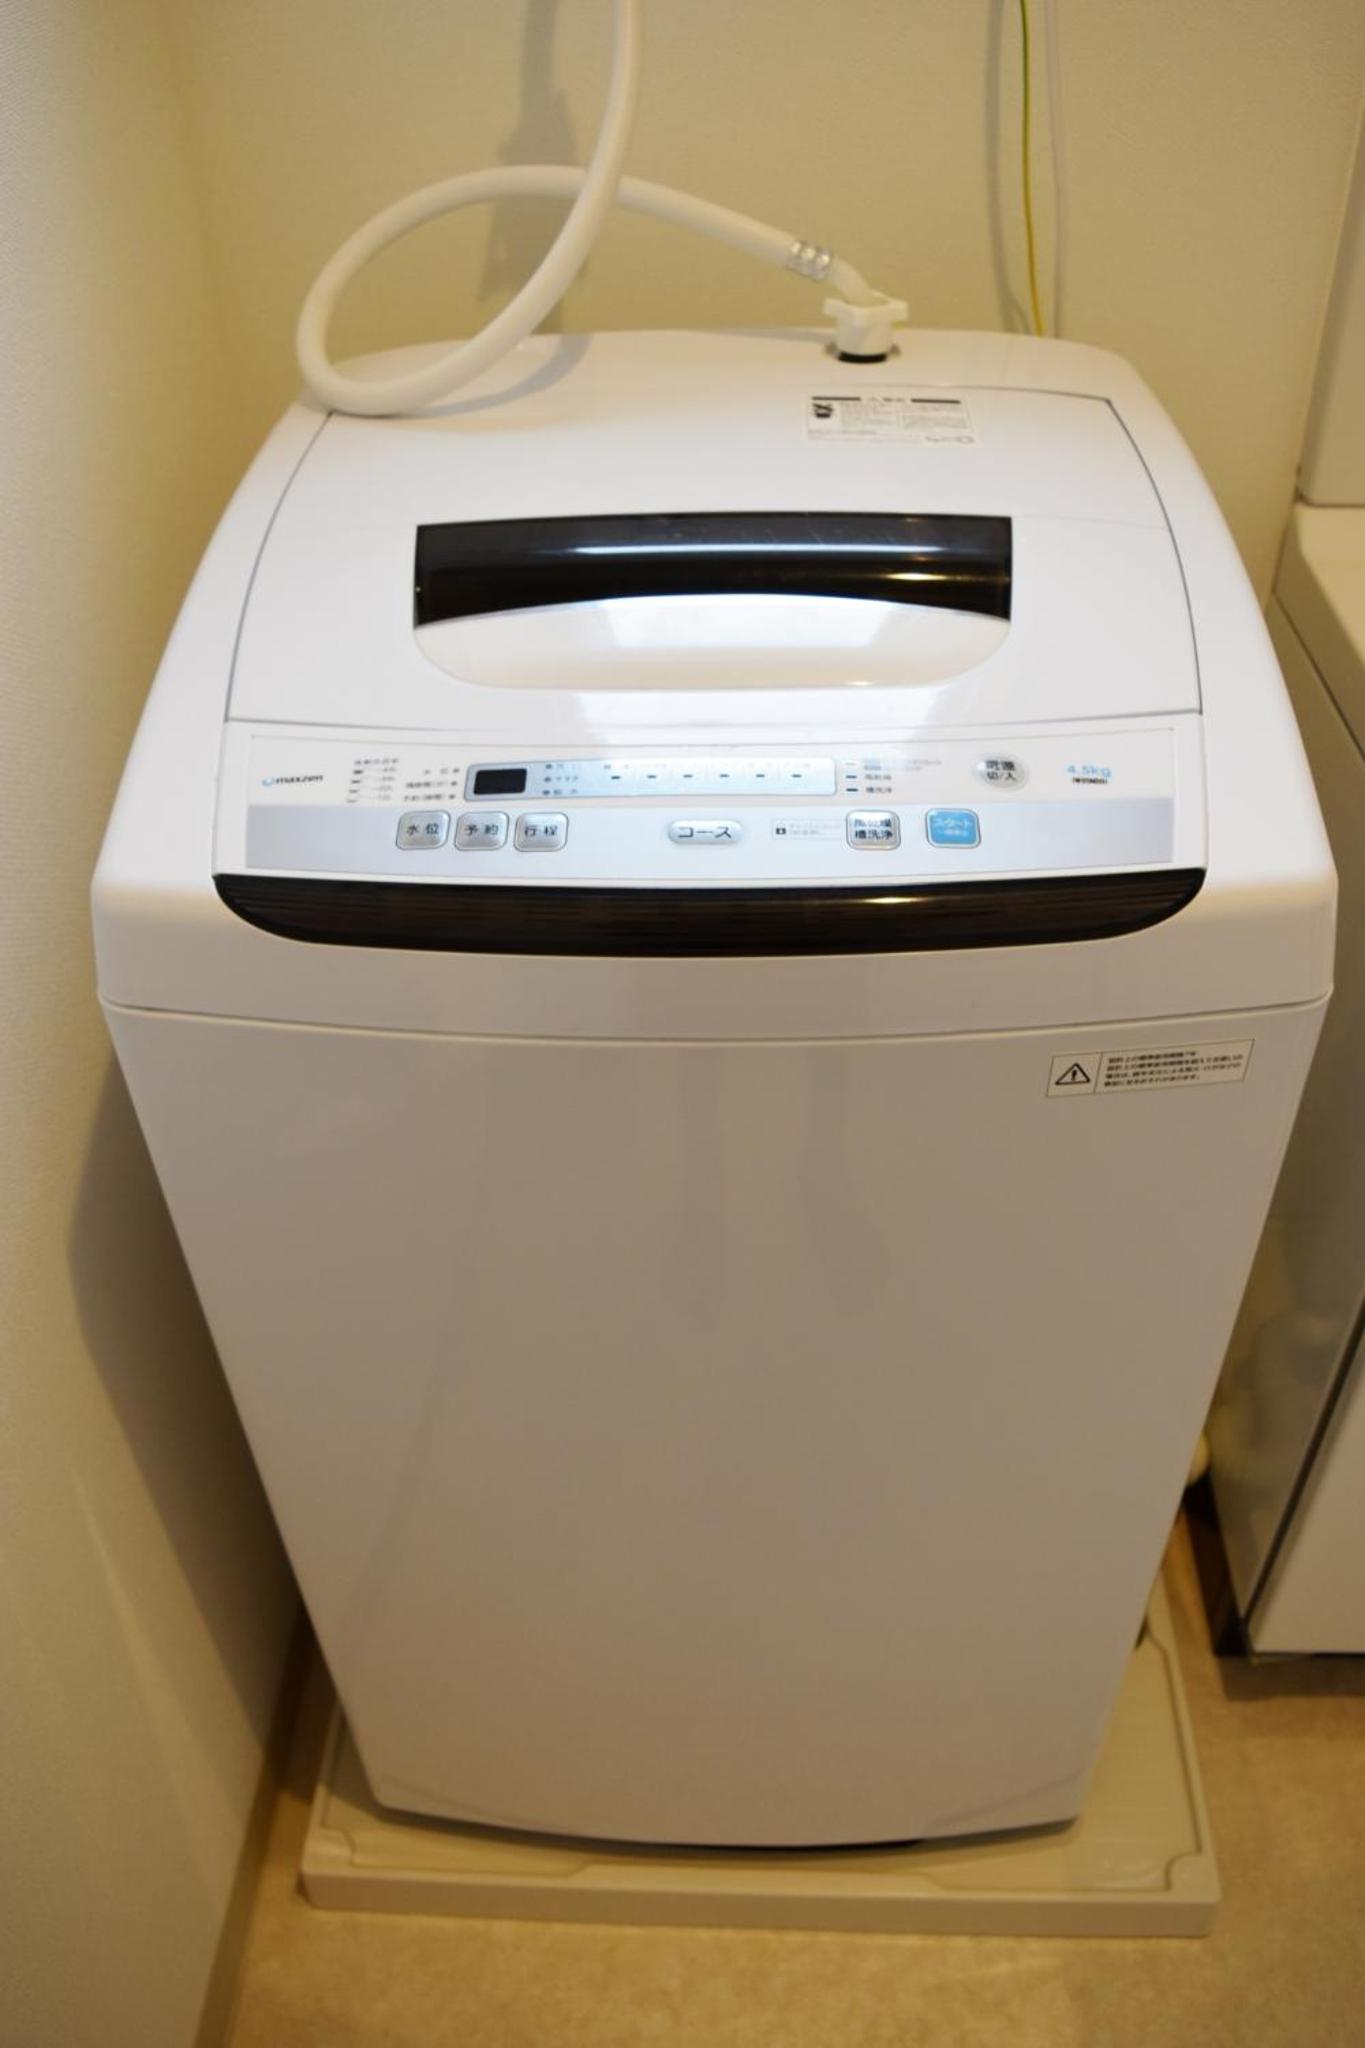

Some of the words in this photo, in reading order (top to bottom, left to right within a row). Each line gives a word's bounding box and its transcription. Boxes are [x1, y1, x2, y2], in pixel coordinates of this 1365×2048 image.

[1066, 763, 1112, 778] 4.5kg
[677, 826, 732, 839] コース
